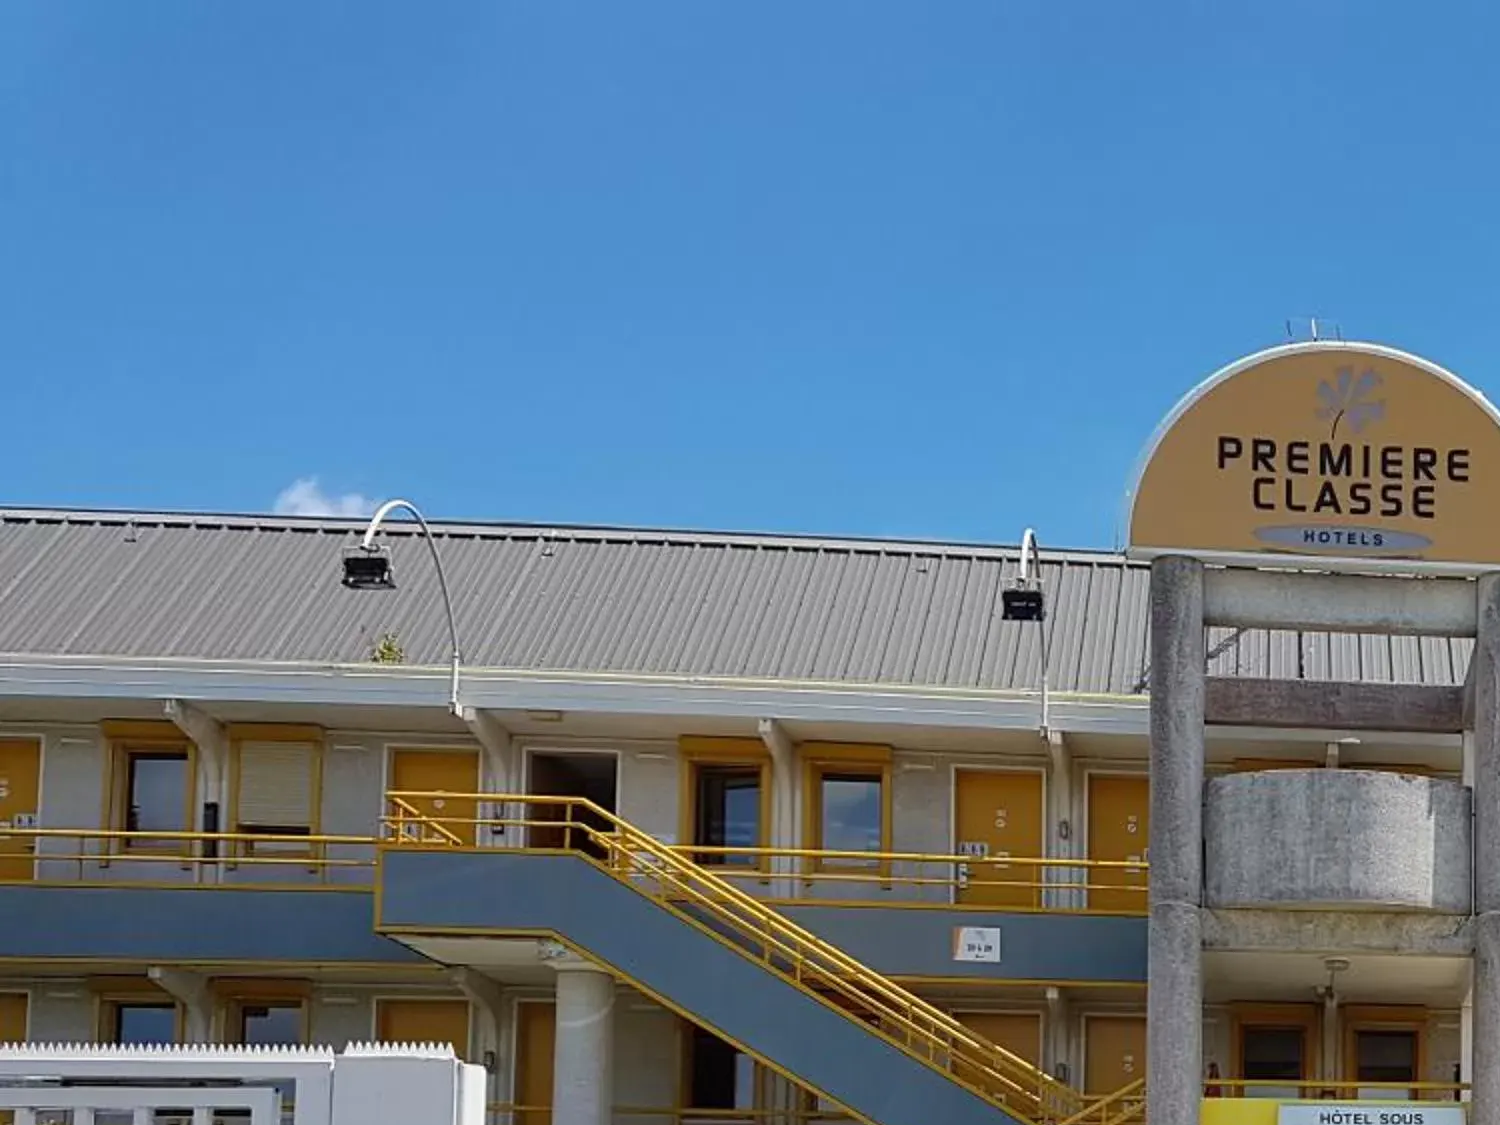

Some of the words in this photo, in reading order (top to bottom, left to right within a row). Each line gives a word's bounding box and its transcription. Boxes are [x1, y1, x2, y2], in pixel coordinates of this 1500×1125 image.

[1217, 436, 1470, 482] PREMIERE
[1253, 477, 1434, 518] CLASSE
[1303, 529, 1384, 547] HOTELS
[1319, 1110, 1373, 1125] HÔTEL
[1379, 1113, 1424, 1125] SOUS
